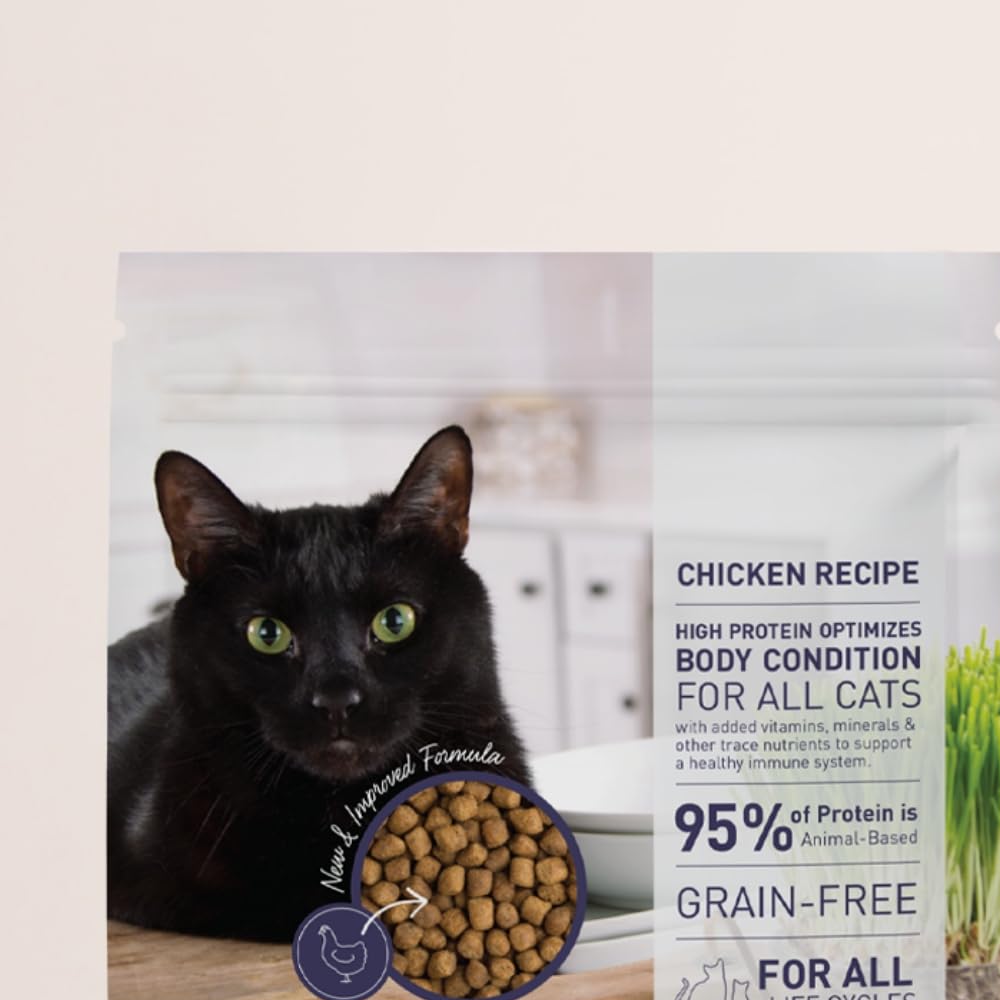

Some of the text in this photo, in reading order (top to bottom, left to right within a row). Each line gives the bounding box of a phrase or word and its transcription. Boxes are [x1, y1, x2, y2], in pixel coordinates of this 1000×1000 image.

[677, 560, 919, 586] CHICKEN RECIPE
[675, 621, 922, 640] HIGH PROTEIN OPTIMIZES
[676, 646, 921, 672] BODY CONDITION
[678, 679, 921, 711] FOR ALL CATS
[675, 718, 915, 735] with added vitamins, minerals &
[675, 736, 912, 753] other trace nutrients to support
[675, 755, 871, 773] a healthy immune system.
[320, 742, 504, 894] New & Improved Formula
[674, 803, 918, 852] 95% of Protein is
[801, 829, 918, 847] Animal-Based
[677, 882, 917, 919] GRAIN-FREE
[759, 956, 913, 990] FOR ALL
